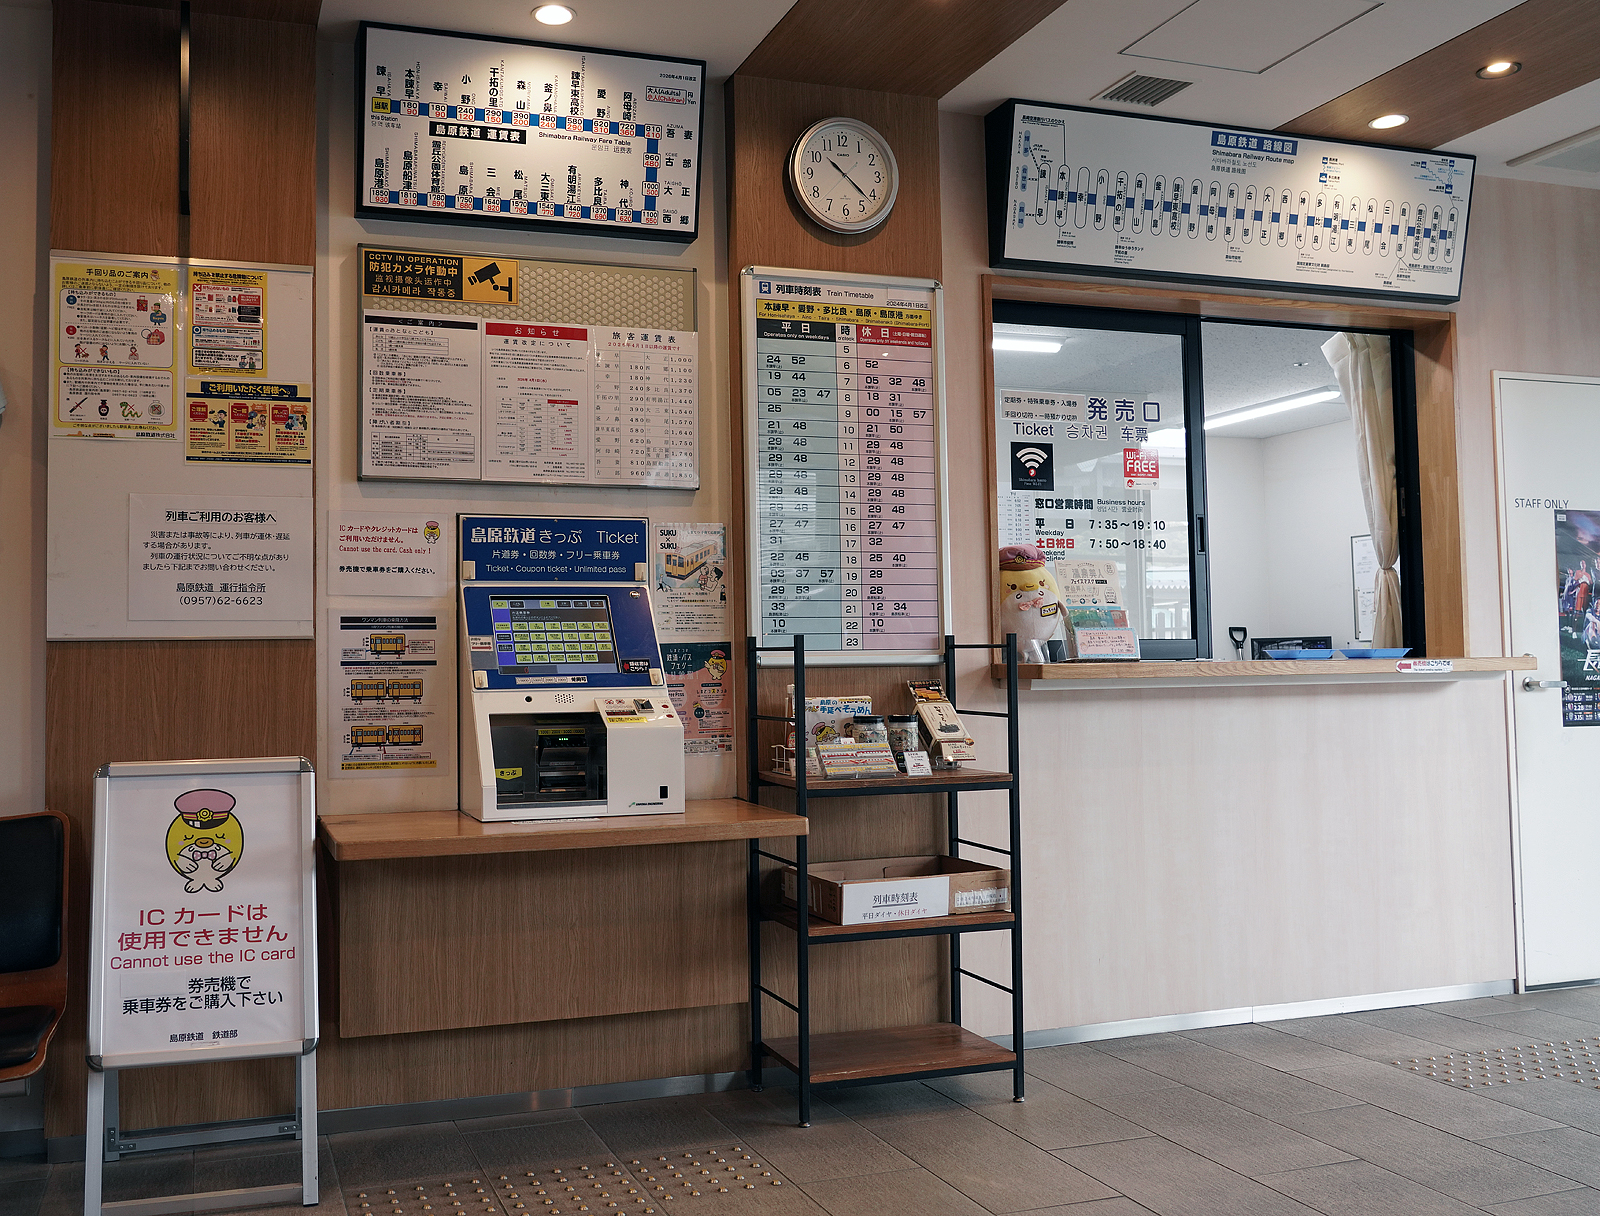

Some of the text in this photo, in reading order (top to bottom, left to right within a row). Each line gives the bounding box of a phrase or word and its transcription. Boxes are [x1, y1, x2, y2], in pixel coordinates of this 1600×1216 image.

[405, 69, 415, 99] 本諫早
[489, 67, 499, 107] 干拓の里
[543, 83, 553, 113] 釜ノ鼻
[570, 71, 580, 115] 諫早東高校
[402, 101, 417, 109] 180
[435, 124, 521, 142] 島原鉄道 運賃表
[539, 131, 571, 140] Shimabara
[573, 135, 597, 144] Railway
[823, 139, 832, 151] 11
[837, 135, 848, 147] 12
[857, 141, 861, 153] 1
[1217, 134, 1292, 153] 島原鉄道 路線図
[811, 151, 822, 163] 10
[869, 154, 875, 166] 2
[1212, 149, 1241, 158] Shimabara
[1243, 153, 1264, 161] Railway
[374, 158, 384, 188] 島原港
[403, 151, 413, 190] 島原船津
[807, 167, 814, 179] 9
[874, 171, 881, 183] 3
[813, 186, 819, 198] 8
[869, 189, 876, 200] 4
[827, 199, 833, 211] 7
[842, 204, 849, 216] 6
[859, 200, 865, 212] 5
[408, 256, 459, 265] OPERATION
[86, 269, 149, 279] 手回り品のご案内
[369, 262, 458, 277] 防犯カメラ作動中
[372, 284, 455, 297] 감시카메라 작동중
[776, 284, 821, 297] 列車時刻表
[844, 291, 874, 299] Timetable
[514, 327, 560, 337] お知らせ
[841, 326, 850, 335] 時
[612, 332, 676, 344] 旅客運賃表
[843, 346, 850, 354] 5
[791, 357, 806, 365] 52
[768, 372, 781, 380] 19
[912, 379, 926, 387] 48
[767, 388, 781, 396] 05
[866, 409, 880, 417] 00
[913, 411, 926, 419] 57
[1087, 397, 1161, 422] 発売口
[1013, 422, 1054, 437] Ticket
[1066, 424, 1108, 440] 승차권
[1121, 426, 1148, 443] 车票
[1126, 461, 1156, 472] FREE
[1035, 498, 1093, 510] 窓口営業時間
[1515, 498, 1569, 509] STAFF ONLY
[165, 510, 277, 523] 列車ご利用のお客様へ
[347, 525, 418, 533] カードやクレジットカードは
[868, 522, 882, 530] 27
[339, 535, 403, 543] ご利用いただけません。
[596, 530, 639, 544] Ticket
[142, 541, 212, 550] する場合があります。
[1036, 538, 1075, 549] 土日祝日
[150, 553, 289, 562] 列車の運行状況についてご不明な点があり
[142, 564, 276, 572] ましたら下記までお問い合わせください。
[339, 566, 435, 574] 券売機で乗車券をご購入ください。
[176, 582, 266, 593] 島原鉄道 運行指令所
[179, 596, 263, 606] (0957)62-6623
[871, 603, 907, 611] 12 34
[846, 622, 858, 630] 22
[846, 638, 859, 646] 23
[499, 769, 517, 777] きっぷ
[872, 892, 918, 905] 列車時刻表
[139, 903, 268, 926] IC カードは
[862, 908, 927, 920] 平日ダイヤ・休日ダイヤ
[117, 925, 289, 952] 使用できません
[110, 947, 296, 970] Cannot use the IC card
[188, 975, 251, 994] 券売機で
[122, 990, 283, 1015] 乗車券をご購入下さい
[169, 1029, 238, 1043] 島原鉄道 鉄道部
